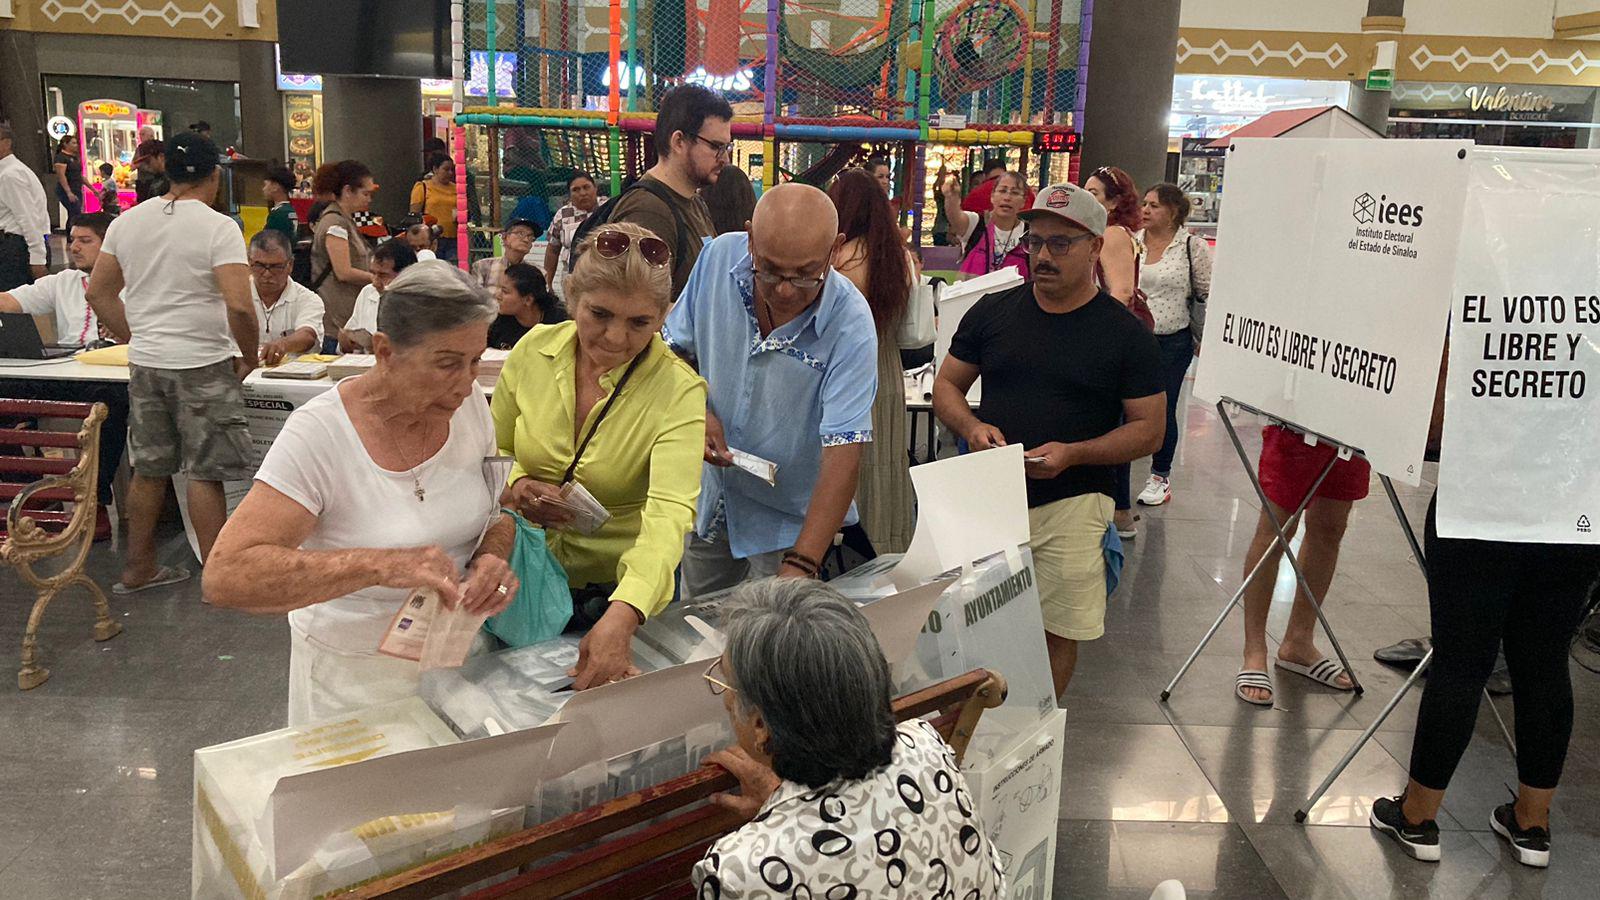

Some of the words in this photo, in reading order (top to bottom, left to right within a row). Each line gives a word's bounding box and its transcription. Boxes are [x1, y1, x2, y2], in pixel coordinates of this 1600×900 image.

[1465, 86, 1555, 113] Valentina
[1378, 194, 1424, 227] iees
[1348, 238, 1359, 250] del
[1359, 240, 1381, 253] Estado
[1382, 243, 1391, 255] de
[1391, 244, 1418, 259] Sinaloa
[1355, 226, 1383, 240] Instituto
[1383, 230, 1414, 244] Electoral
[1462, 295, 1492, 323] EL
[1502, 295, 1566, 324] VOTO
[1574, 295, 1600, 324] ES
[1222, 312, 1235, 344] EL
[1237, 316, 1266, 354] VOTO
[1265, 324, 1281, 359] ES
[1281, 329, 1319, 371] LIBRE
[1320, 338, 1332, 374] Y
[1331, 342, 1397, 395] SECRETO
[1483, 333, 1558, 361] LIBRE
[1566, 333, 1582, 361] Y
[1471, 369, 1586, 399] SECRETO
[245, 400, 288, 410] SPECIAL
[963, 566, 1033, 628] AYUNTAMIENTO
